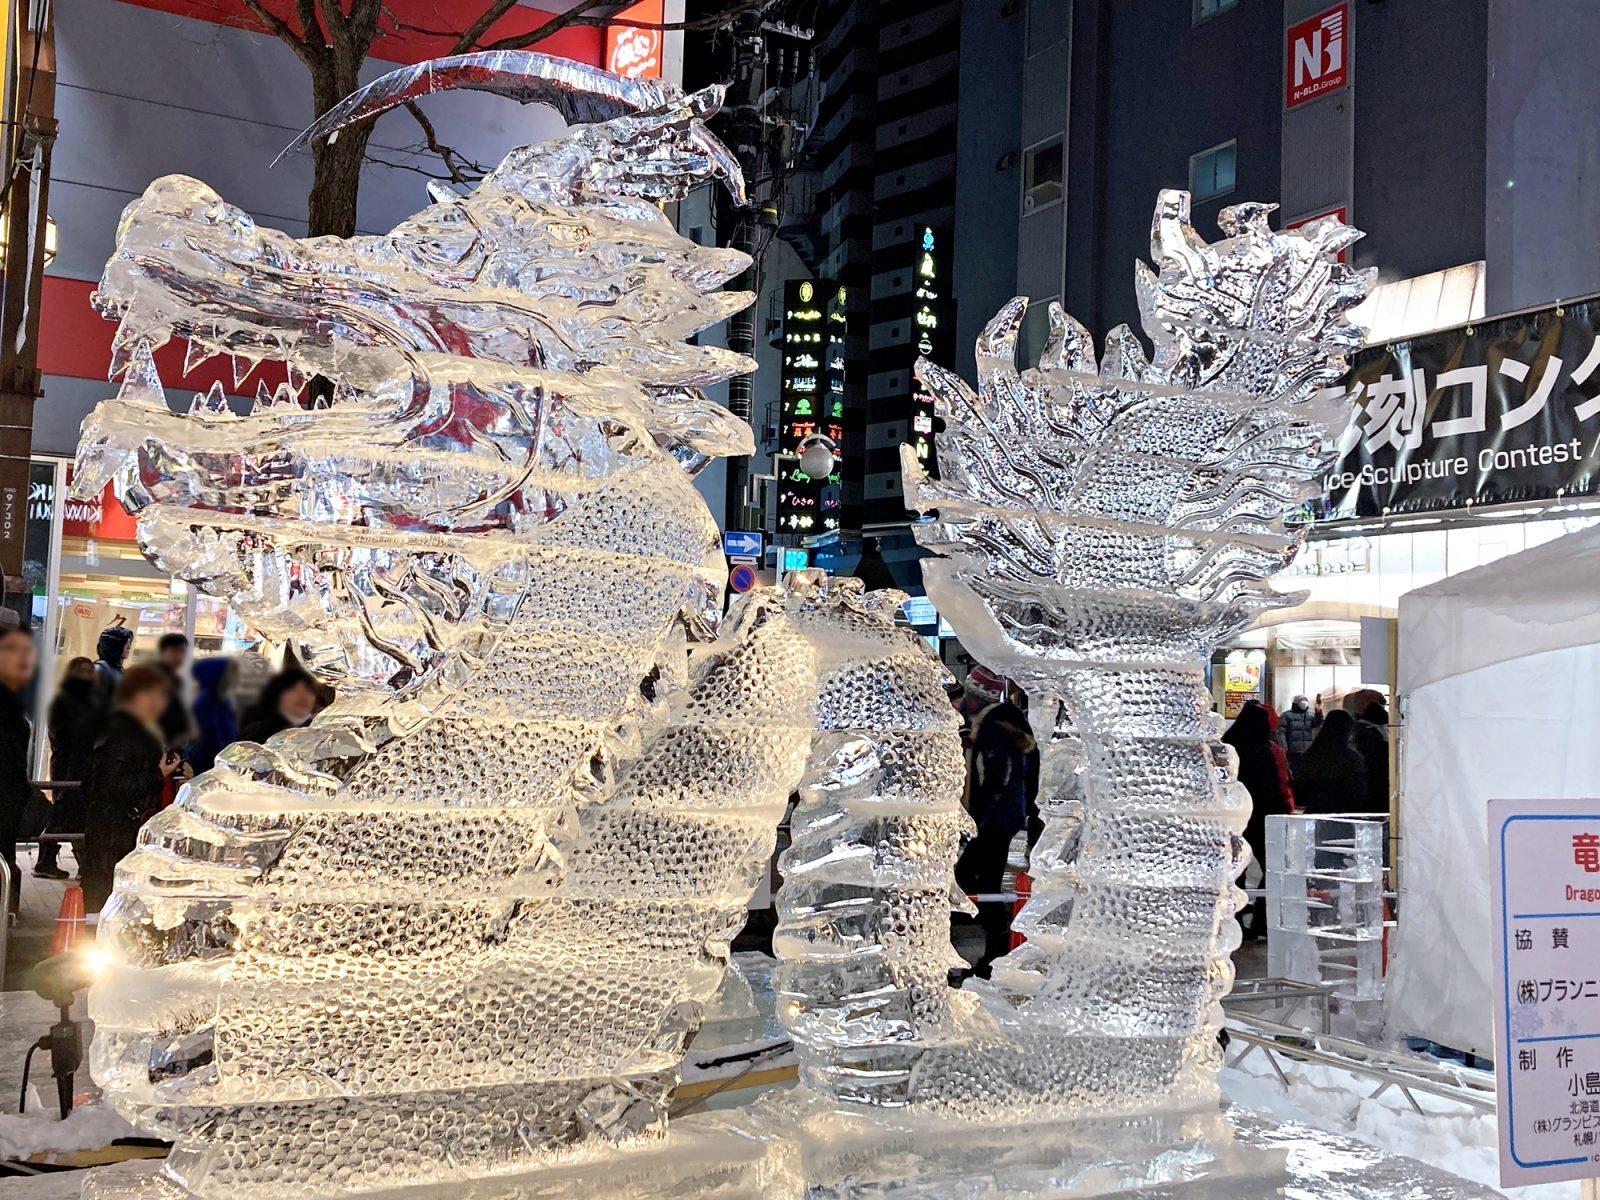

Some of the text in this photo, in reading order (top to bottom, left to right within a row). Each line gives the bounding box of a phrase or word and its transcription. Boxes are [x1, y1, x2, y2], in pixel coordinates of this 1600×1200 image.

[1294, 76, 1342, 100] N-BLD.Group
[1323, 438, 1582, 491] Ice Sculpture Contest
[4, 493, 13, 539] 97302
[1572, 832, 1600, 872] 竜
[1566, 884, 1600, 902] Drago
[1515, 928, 1569, 950] 協 賛
[1518, 1046, 1574, 1072] 制 作
